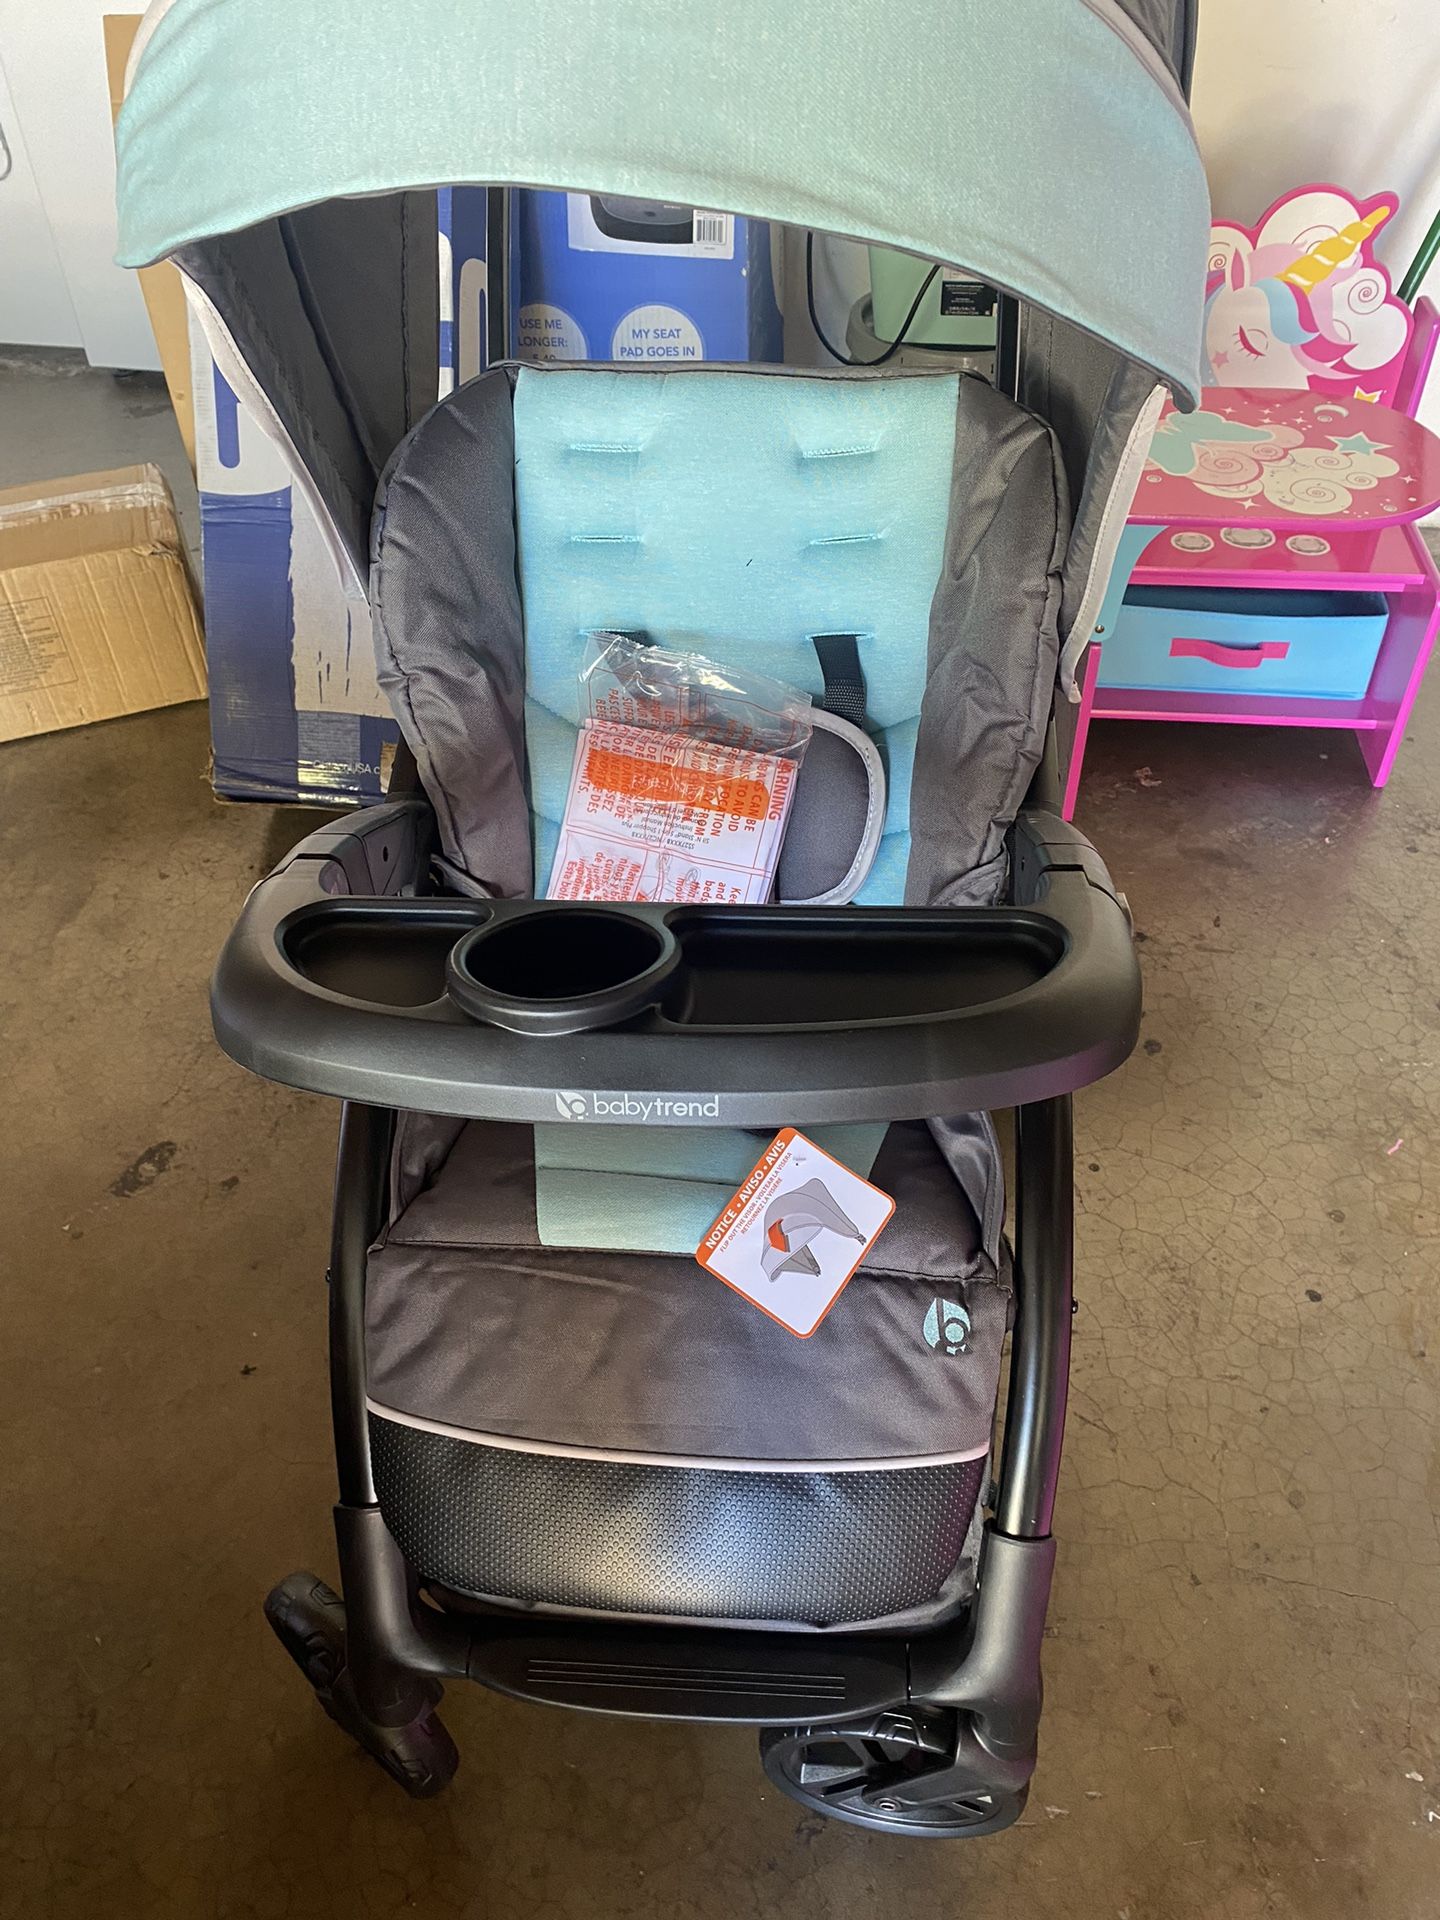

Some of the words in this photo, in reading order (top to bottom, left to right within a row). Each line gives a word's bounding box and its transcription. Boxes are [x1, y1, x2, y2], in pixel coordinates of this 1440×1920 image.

[520, 319, 541, 331] USE
[544, 319, 563, 331] ME
[632, 328, 650, 339] MY
[654, 328, 682, 339] SEAT
[518, 336, 568, 348] LONGER:
[620, 346, 643, 357] PAD
[646, 346, 679, 357] GOES
[682, 346, 695, 357] IN
[646, 747, 657, 760] DE
[736, 784, 747, 797] TO
[587, 794, 599, 813] DES
[615, 806, 625, 819] DE
[748, 794, 762, 816] CAN
[642, 817, 662, 825] Manual
[695, 807, 709, 836] FROM
[729, 800, 743, 832] AVOID
[745, 819, 756, 832] BE
[595, 852, 606, 863] de
[564, 861, 576, 880] Esta
[569, 858, 586, 900] impidien
[558, 882, 569, 900] bols
[618, 864, 640, 901] Manteng
[673, 878, 687, 902] mout
[688, 881, 701, 898] thin
[716, 882, 728, 900] and
[728, 888, 741, 905] Kee
[594, 1093, 719, 1120] babytrend
[705, 1209, 737, 1249] NOTICE
[737, 1169, 765, 1203] AVISO
[764, 1140, 786, 1165] AVIS
[720, 1240, 730, 1252] FLIP
[728, 1229, 738, 1240] OUT
[737, 1218, 745, 1228] THE
[744, 1203, 756, 1218] VISOR
[757, 1177, 775, 1199] VOLTEAR
[740, 1203, 764, 1234] RETOURNEZ
